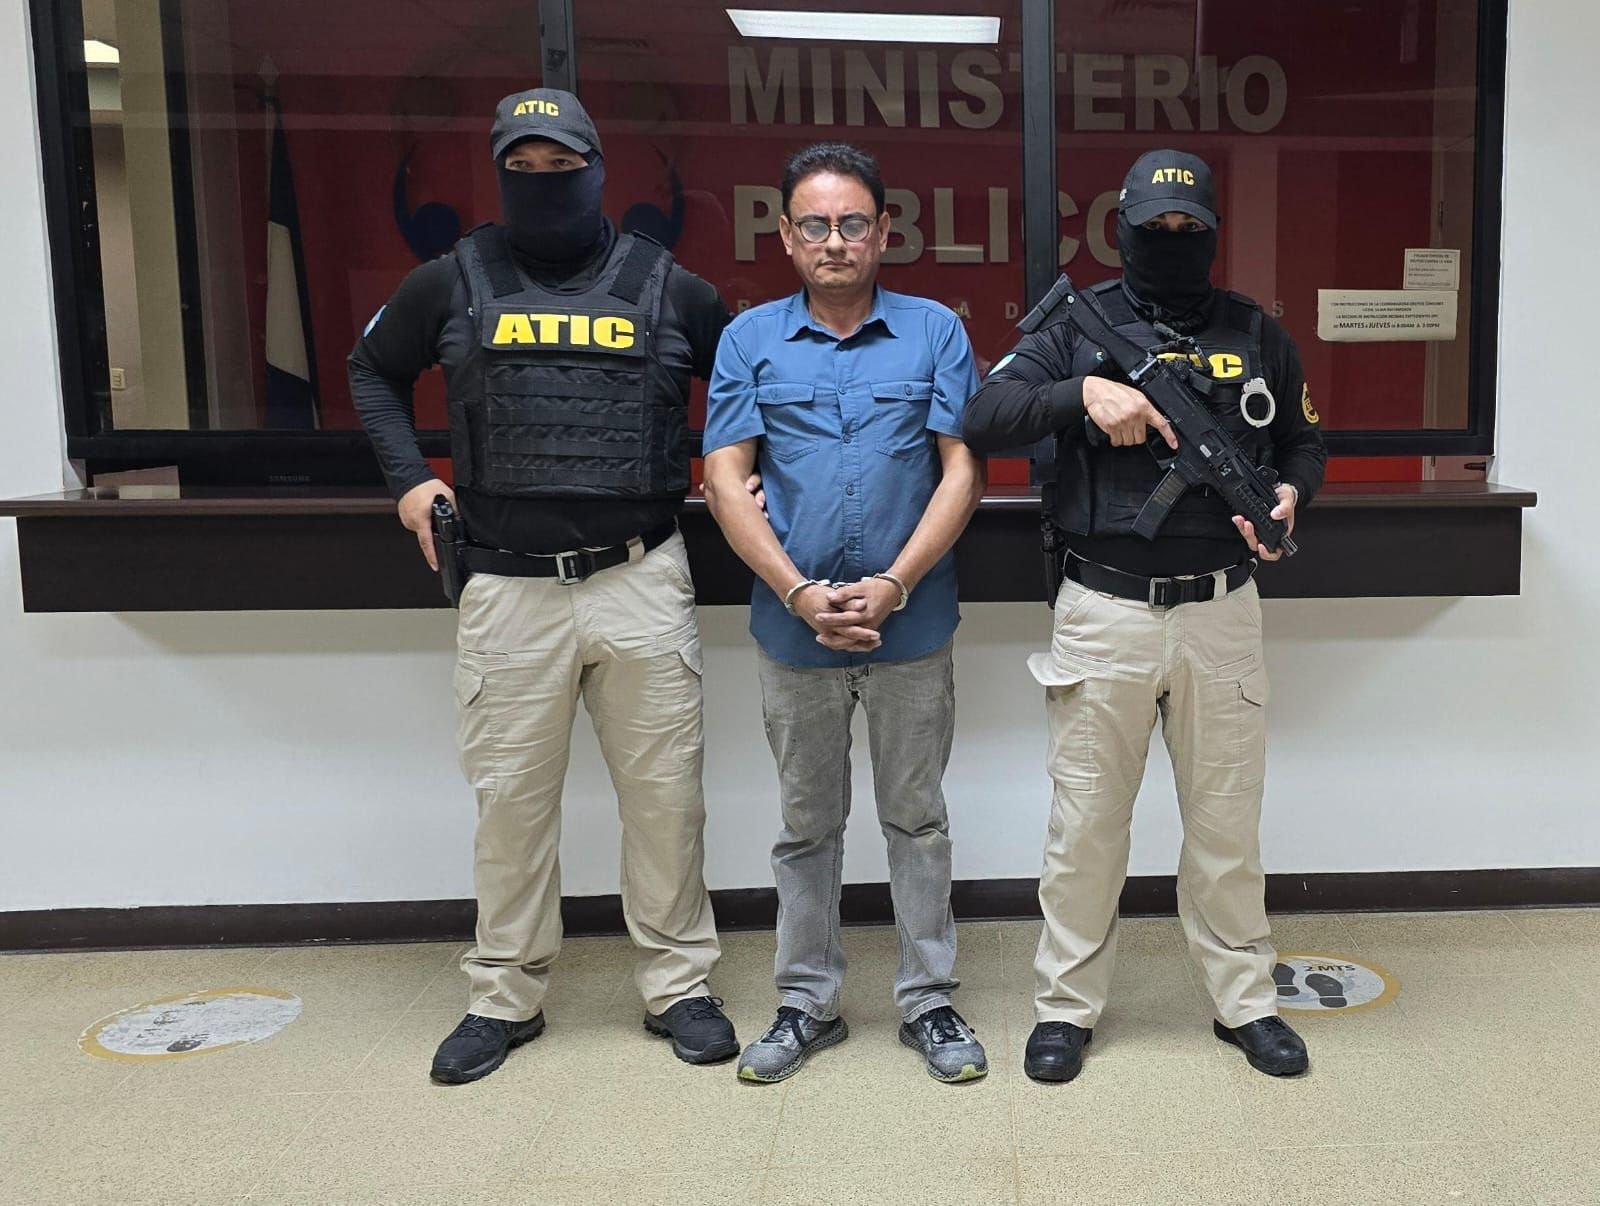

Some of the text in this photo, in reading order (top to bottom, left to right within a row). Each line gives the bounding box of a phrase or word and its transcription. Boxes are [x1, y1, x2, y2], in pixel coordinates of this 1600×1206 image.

[727, 45, 1288, 133] MINISERIO
[513, 100, 559, 117] ATIC
[1151, 168, 1195, 186] ATIC
[492, 313, 635, 349] ATIC
